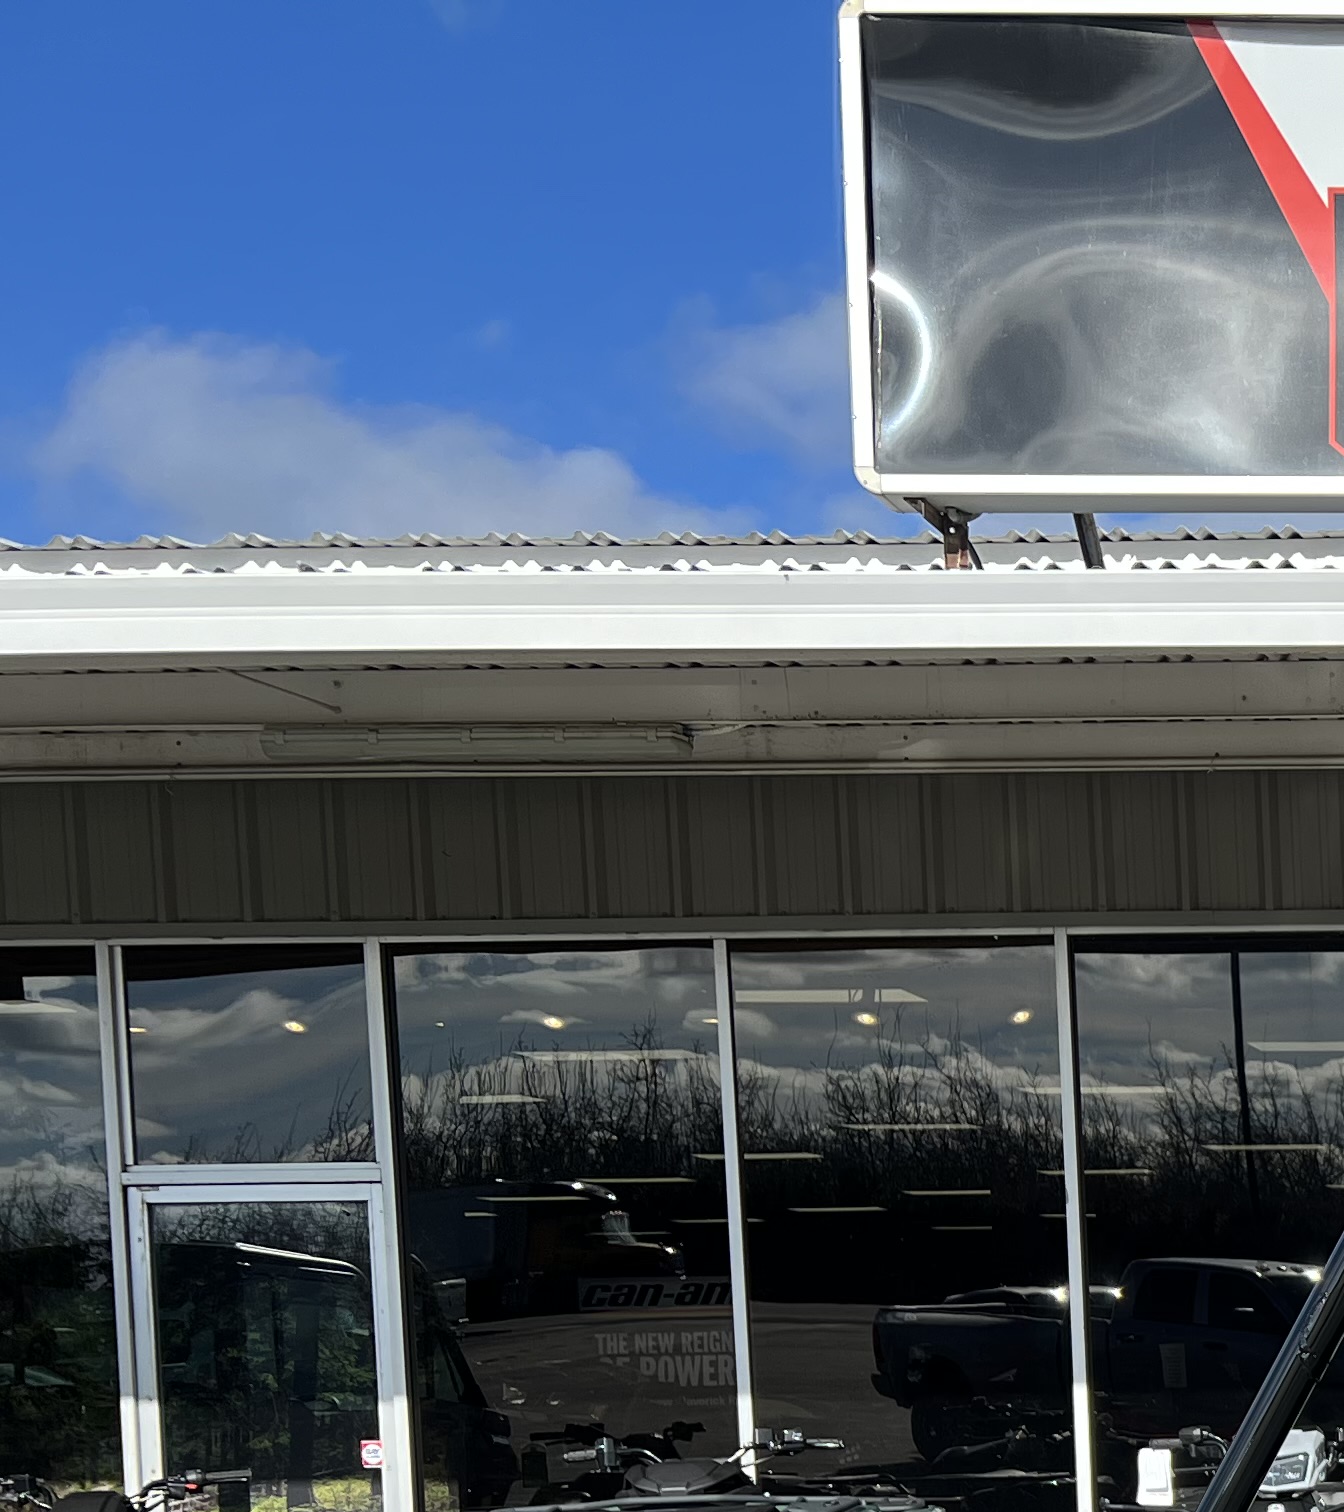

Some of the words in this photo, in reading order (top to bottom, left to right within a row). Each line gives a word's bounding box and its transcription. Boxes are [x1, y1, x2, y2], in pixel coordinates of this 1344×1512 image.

[594, 1332, 629, 1355] THE
[634, 1331, 675, 1354] NEW
[681, 1330, 734, 1353] REIGN
[640, 1355, 736, 1387] POWER
